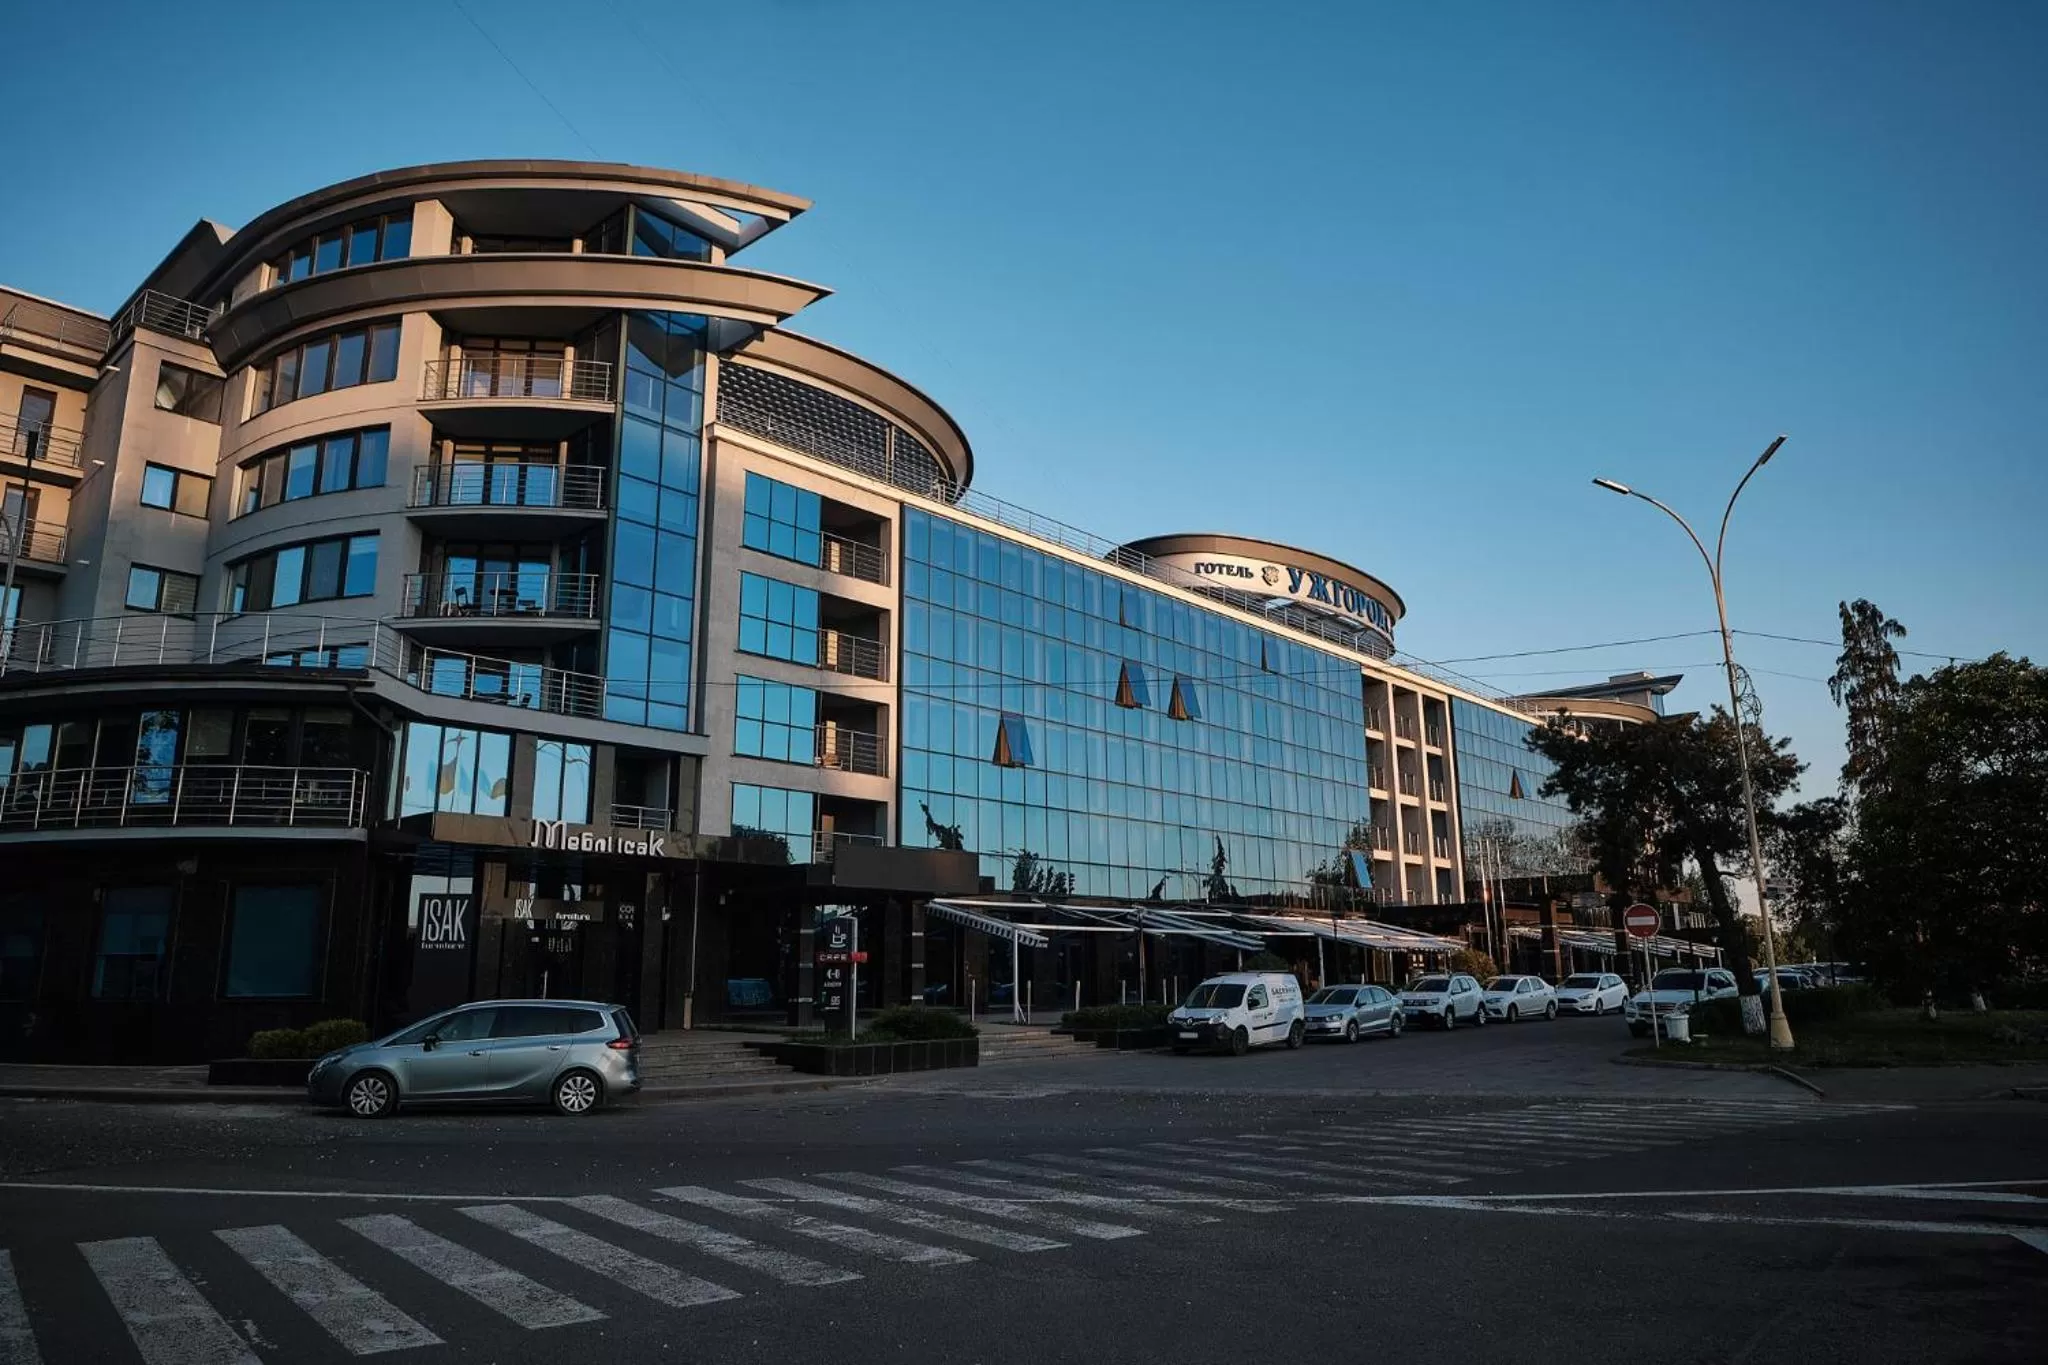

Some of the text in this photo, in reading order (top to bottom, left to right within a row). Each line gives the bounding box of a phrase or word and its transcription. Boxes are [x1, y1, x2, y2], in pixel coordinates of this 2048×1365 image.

[1194, 562, 1254, 579] ГОТЕЛЬ
[514, 898, 534, 919] ISAK
[421, 898, 469, 941] ISAK
